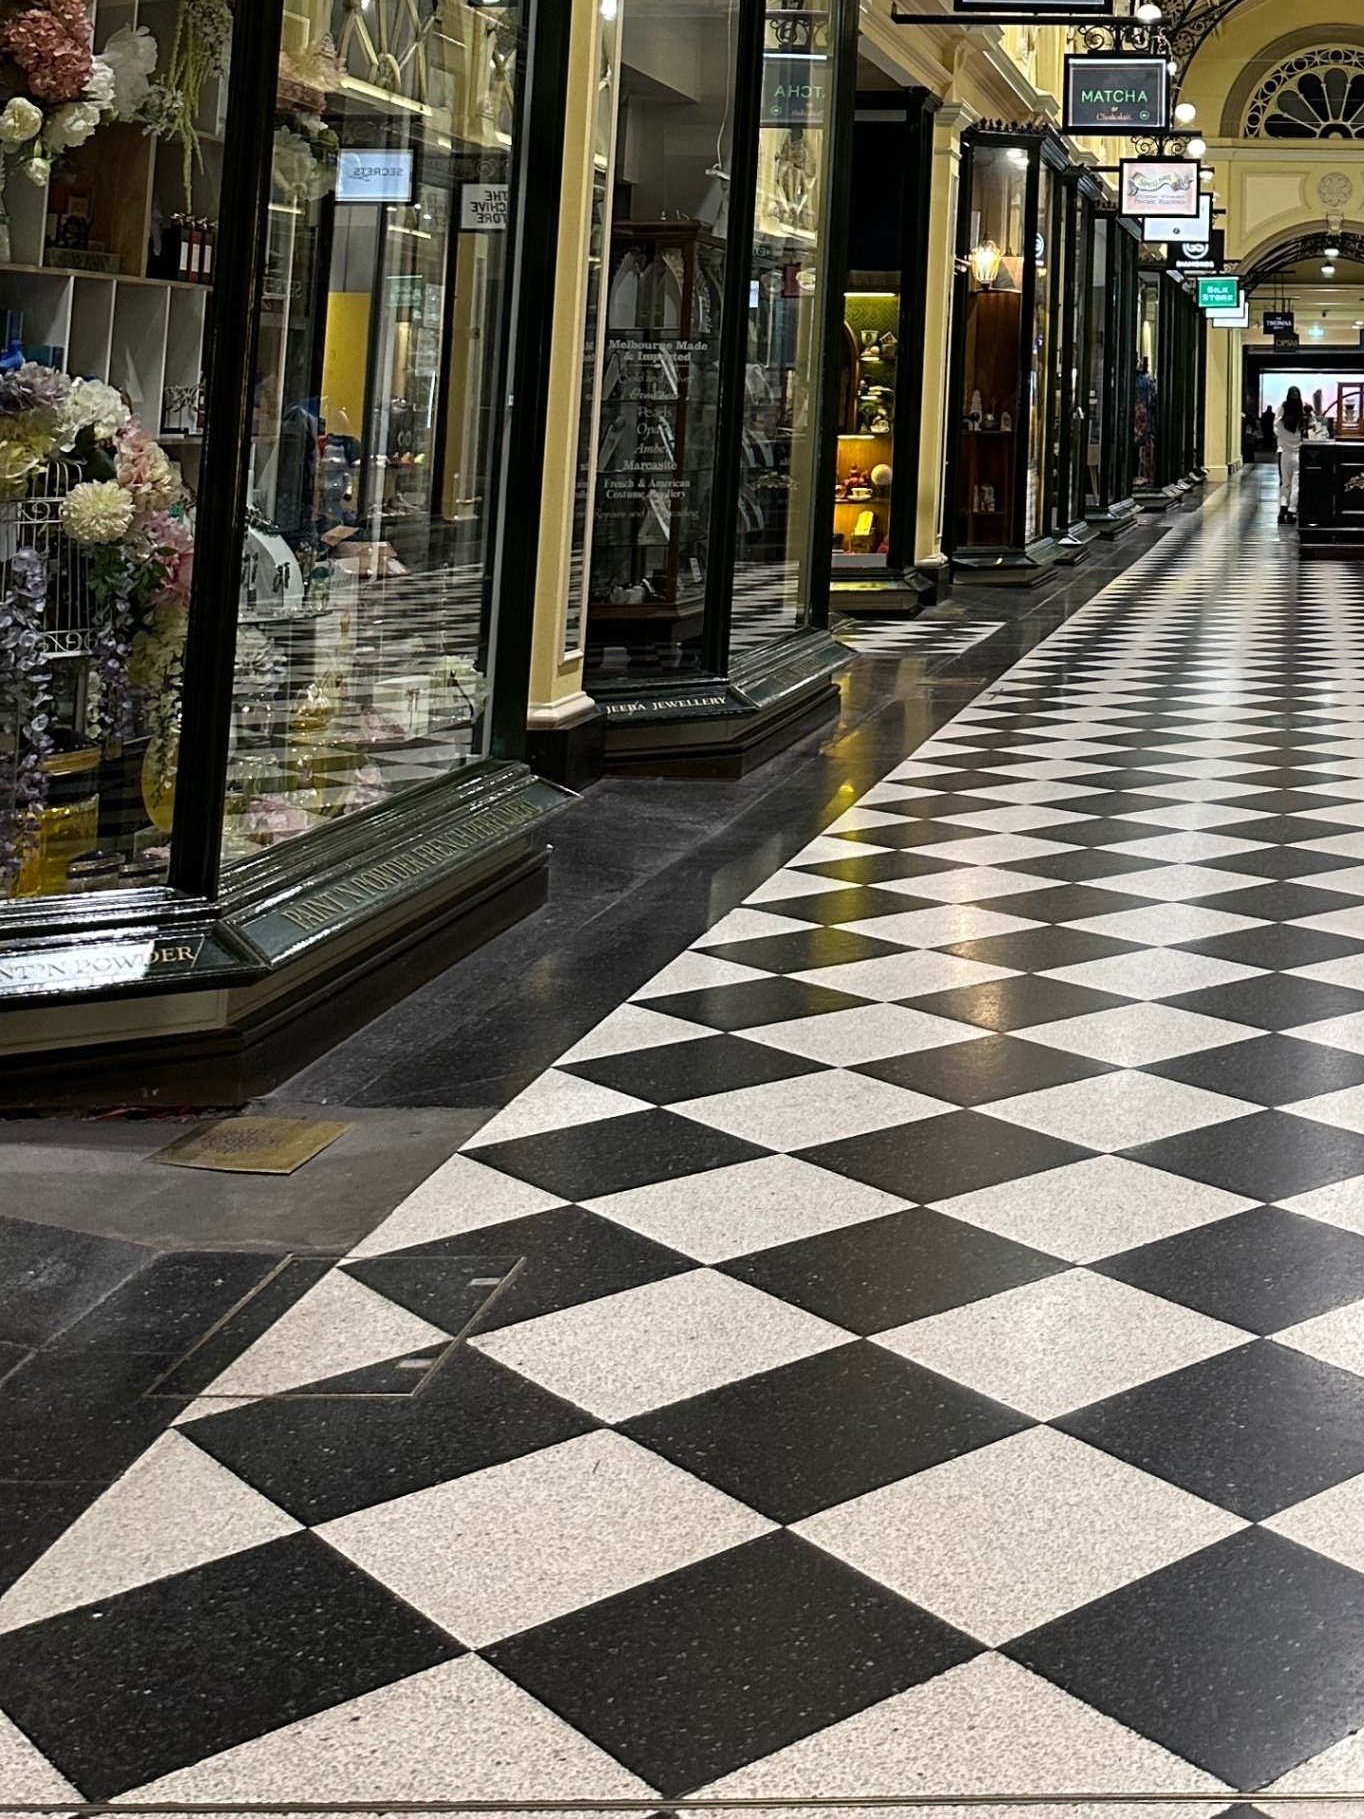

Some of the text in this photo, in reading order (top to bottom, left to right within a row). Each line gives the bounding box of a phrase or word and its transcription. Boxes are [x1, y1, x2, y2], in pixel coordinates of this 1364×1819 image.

[1081, 90, 1148, 103] MATCHA
[608, 339, 708, 351] Melbourne Made
[623, 460, 678, 471] Marcasite
[604, 479, 635, 489] French
[648, 479, 691, 489] American
[606, 696, 727, 715] JEEBA JEWELLERY
[280, 890, 350, 931] PAINT
[350, 853, 427, 899] POWDER
[412, 827, 479, 866] FRENCH
[76, 945, 196, 975] POWDER
